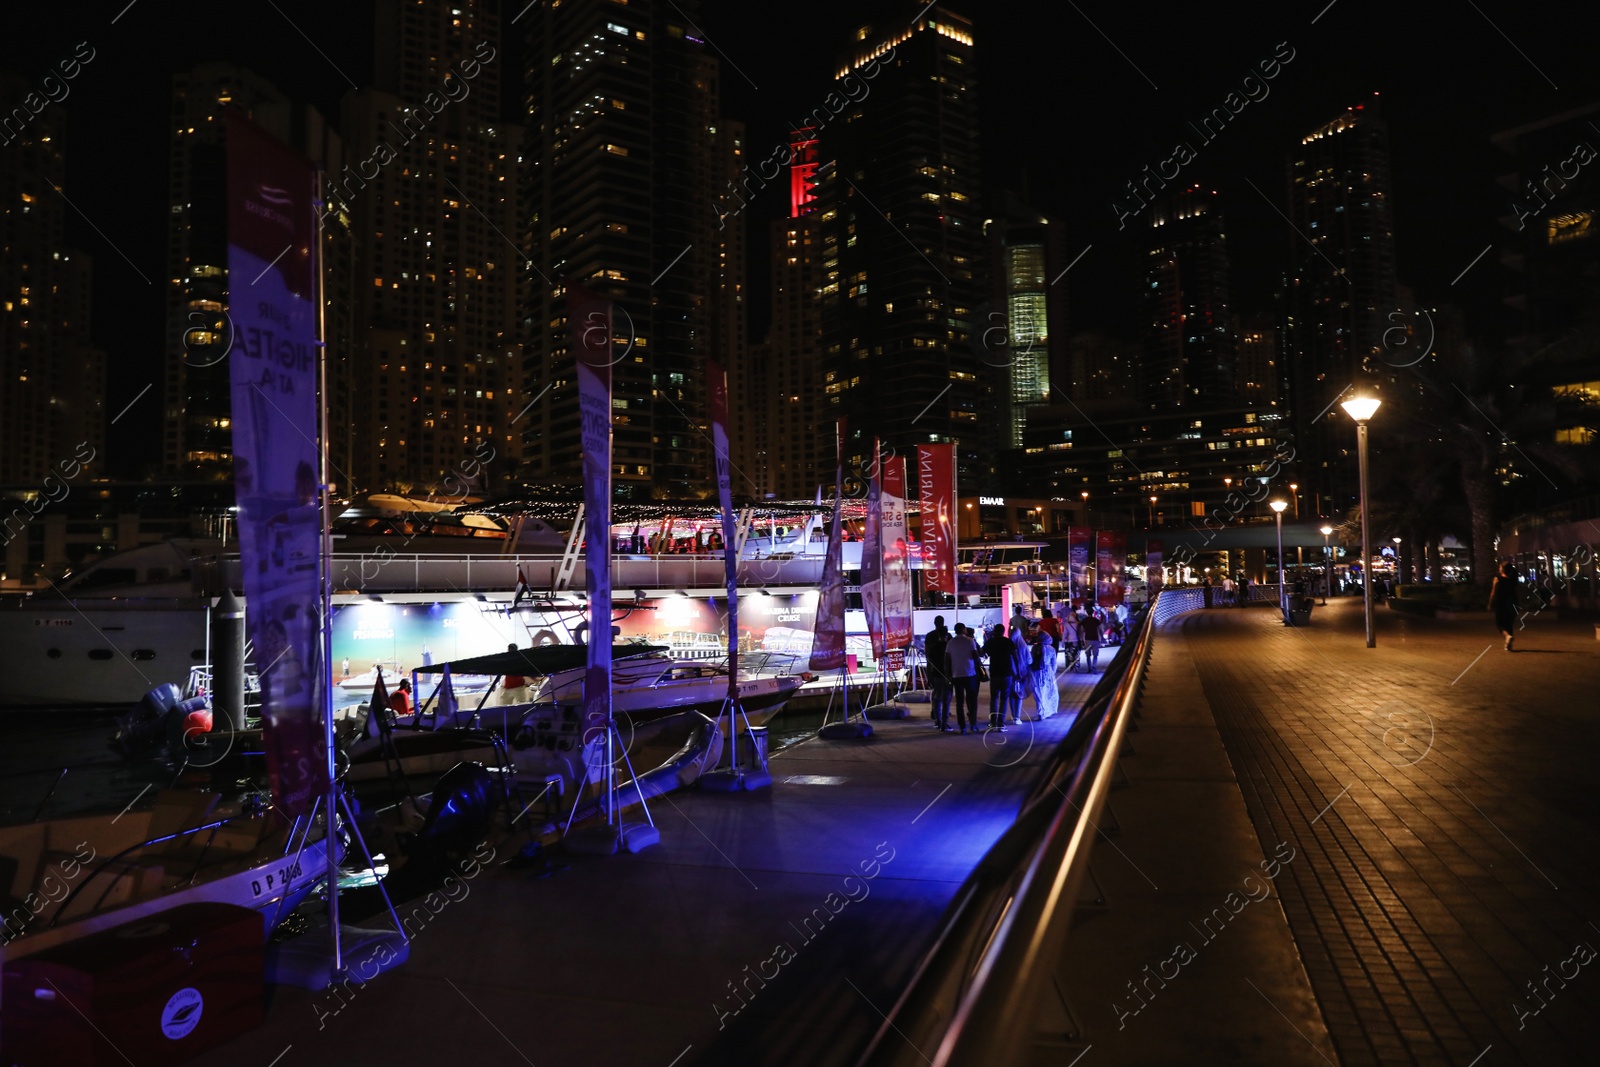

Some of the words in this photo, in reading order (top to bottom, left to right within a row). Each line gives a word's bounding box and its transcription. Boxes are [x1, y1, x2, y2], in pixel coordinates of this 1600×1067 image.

[979, 496, 1004, 506] EMAAR
[252, 880, 261, 896] D
[266, 874, 274, 890] P
